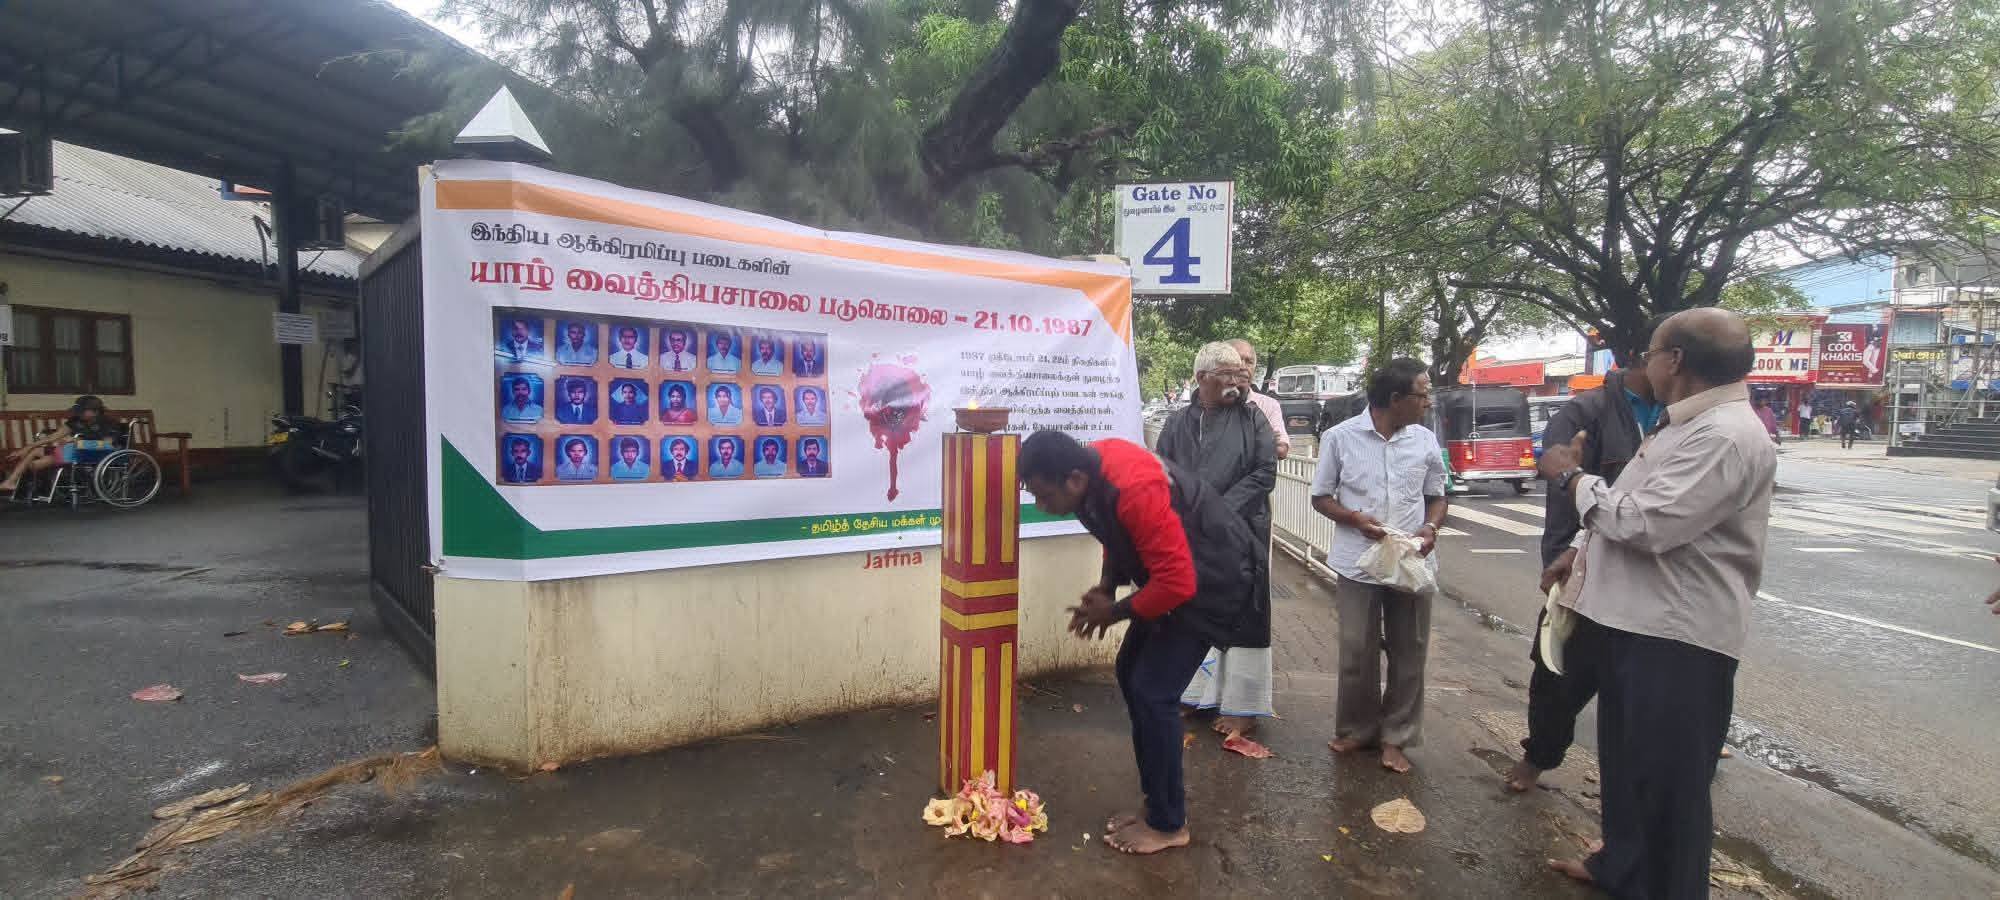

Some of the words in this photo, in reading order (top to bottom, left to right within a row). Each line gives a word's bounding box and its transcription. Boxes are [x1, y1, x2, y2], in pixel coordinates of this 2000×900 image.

[1132, 186, 1181, 201] Gate
[1188, 185, 1217, 200] No
[471, 222, 549, 246] இந்திய
[557, 233, 686, 267] ஆக்கிரமிப்பு
[692, 252, 792, 276] படைகளின்
[1143, 217, 1201, 284] 4
[471, 257, 554, 291] யாழ்
[566, 268, 811, 313] வைத்தியசாலை
[819, 296, 949, 326] படுகொலை
[974, 310, 1093, 336] 21.10.1987
[1821, 352, 1863, 361] KHAKIS
[1827, 343, 1857, 352] COOL
[1790, 358, 1808, 371] ME
[811, 518, 850, 534] தமிழ்த்
[853, 516, 888, 531] தேசிய
[892, 514, 927, 528] மக்கள்
[863, 549, 923, 570] Jaffna
